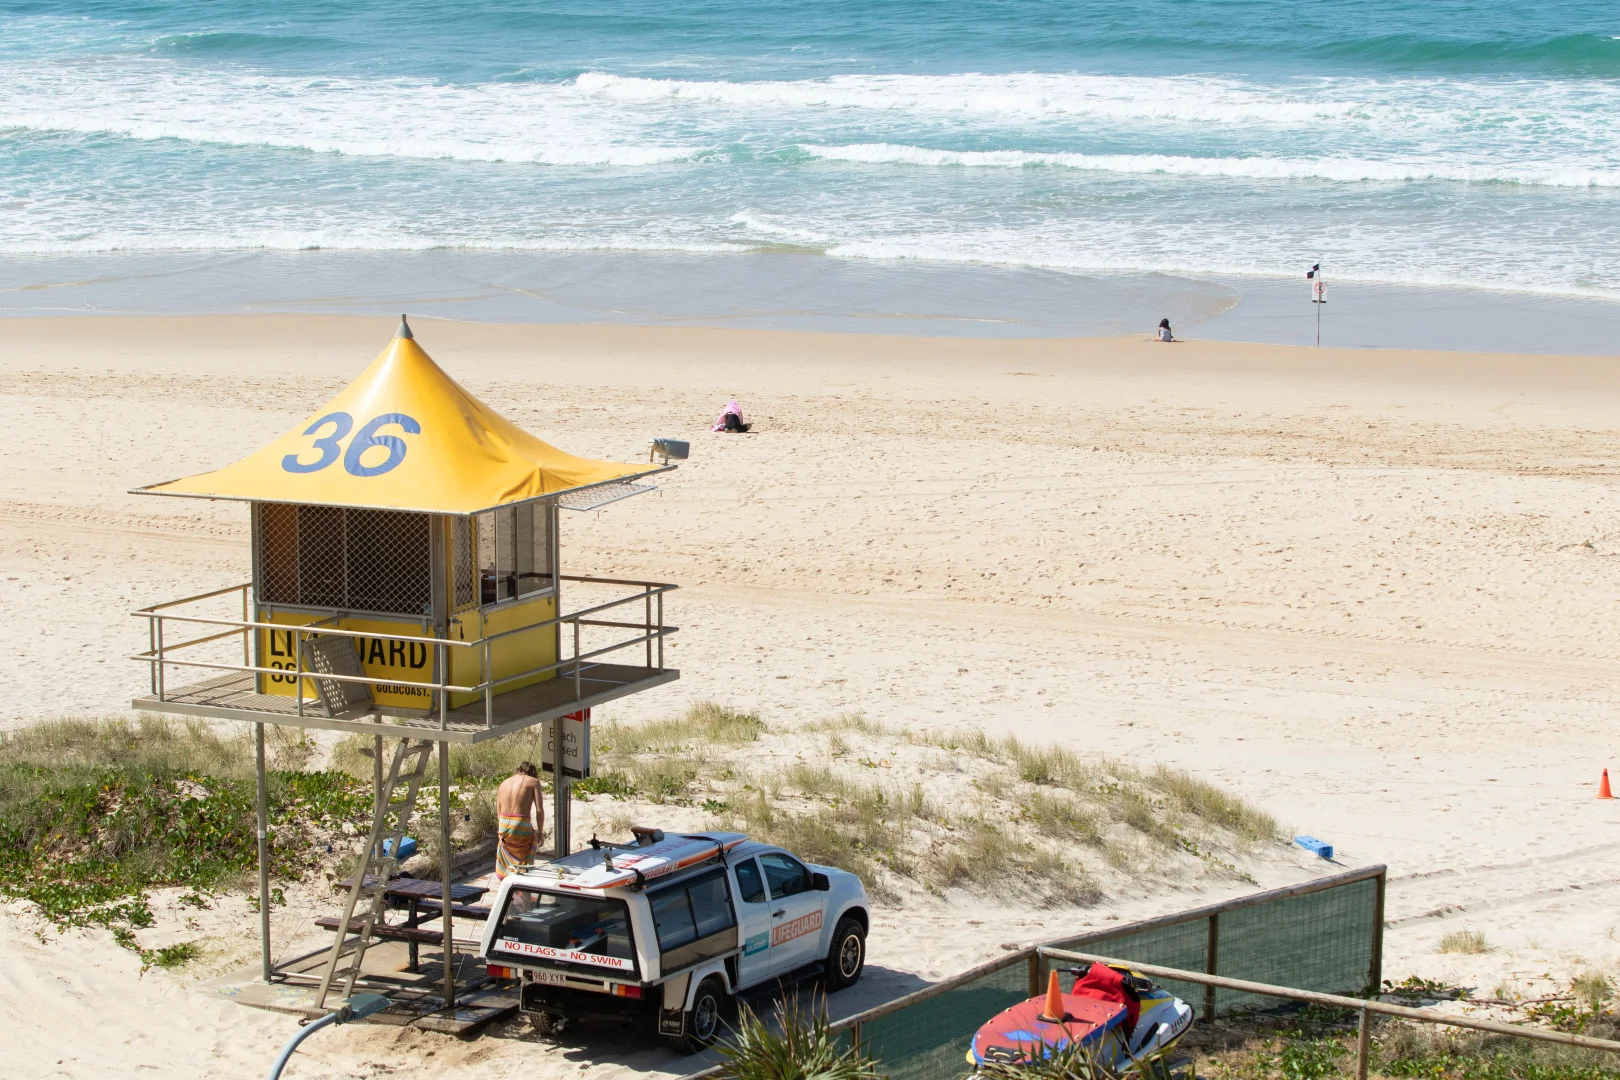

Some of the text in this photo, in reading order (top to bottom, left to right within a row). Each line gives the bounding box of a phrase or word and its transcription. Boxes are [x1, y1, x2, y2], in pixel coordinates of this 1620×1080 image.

[281, 411, 421, 477] 36
[271, 660, 298, 684] 36
[549, 727, 577, 743] Bach
[547, 741, 578, 758] Csed
[772, 913, 821, 944] LIFEGUARD
[504, 941, 521, 950] NO
[524, 945, 557, 957] FLAGS
[570, 951, 587, 961] NO
[591, 955, 622, 966] SWIM
